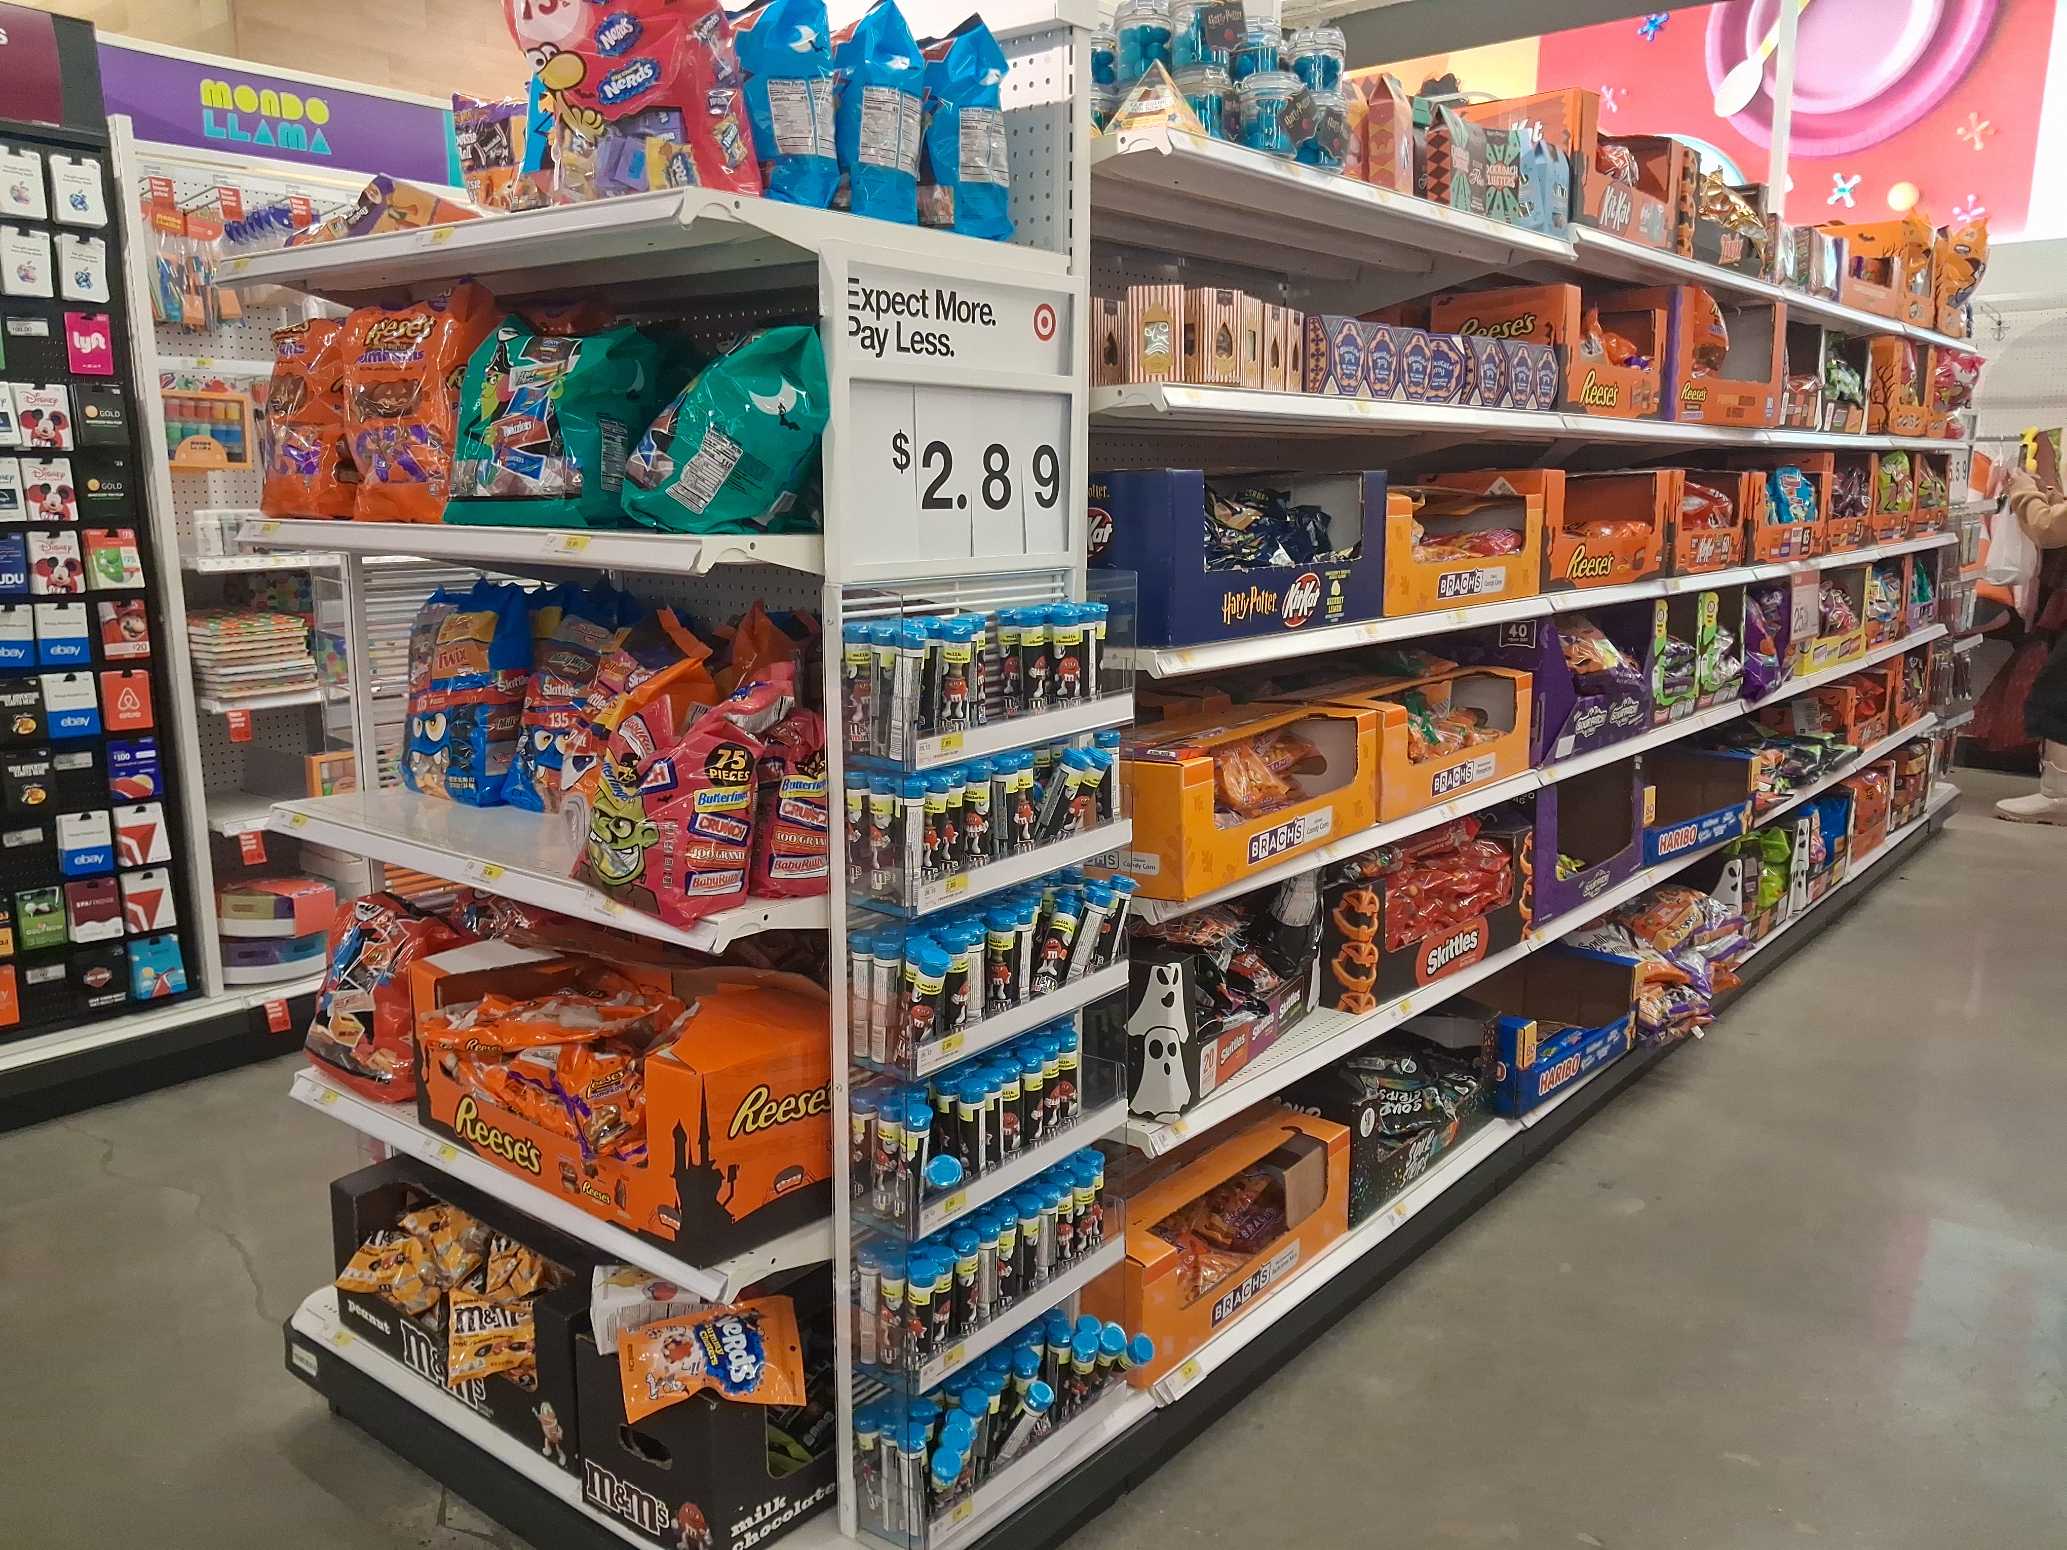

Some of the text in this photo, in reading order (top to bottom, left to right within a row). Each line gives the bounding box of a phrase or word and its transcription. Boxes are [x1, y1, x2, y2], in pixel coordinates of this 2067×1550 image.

[200, 78, 330, 125] MONDO
[203, 109, 332, 155] LLAMA
[848, 277, 996, 326] Expect More.
[848, 316, 955, 358] Pay Less.
[1579, 369, 1619, 408] Reese's
[1680, 381, 1708, 402] Reese's
[99, 408, 121, 418] GOLD
[101, 481, 122, 490] GOLD
[1567, 545, 1613, 579] Reese's
[1221, 591, 1250, 625] Harry
[1508, 623, 1528, 638] 40
[50, 644, 80, 657] ebay
[60, 715, 90, 728] ebay
[550, 712, 570, 728] 135
[709, 769, 750, 782] PIECES
[714, 750, 746, 769] 75
[776, 833, 798, 844] 100
[1659, 824, 1698, 856] HARIBO
[74, 853, 104, 866] ebay
[1426, 930, 1479, 976] Skittles
[1539, 1053, 1581, 1096] HARIBO
[455, 1097, 542, 1175] Reese's
[347, 1299, 391, 1335] peanut
[585, 1458, 670, 1536] m&m's
[731, 1494, 787, 1537] milk
[732, 1480, 836, 1550] chocolate
